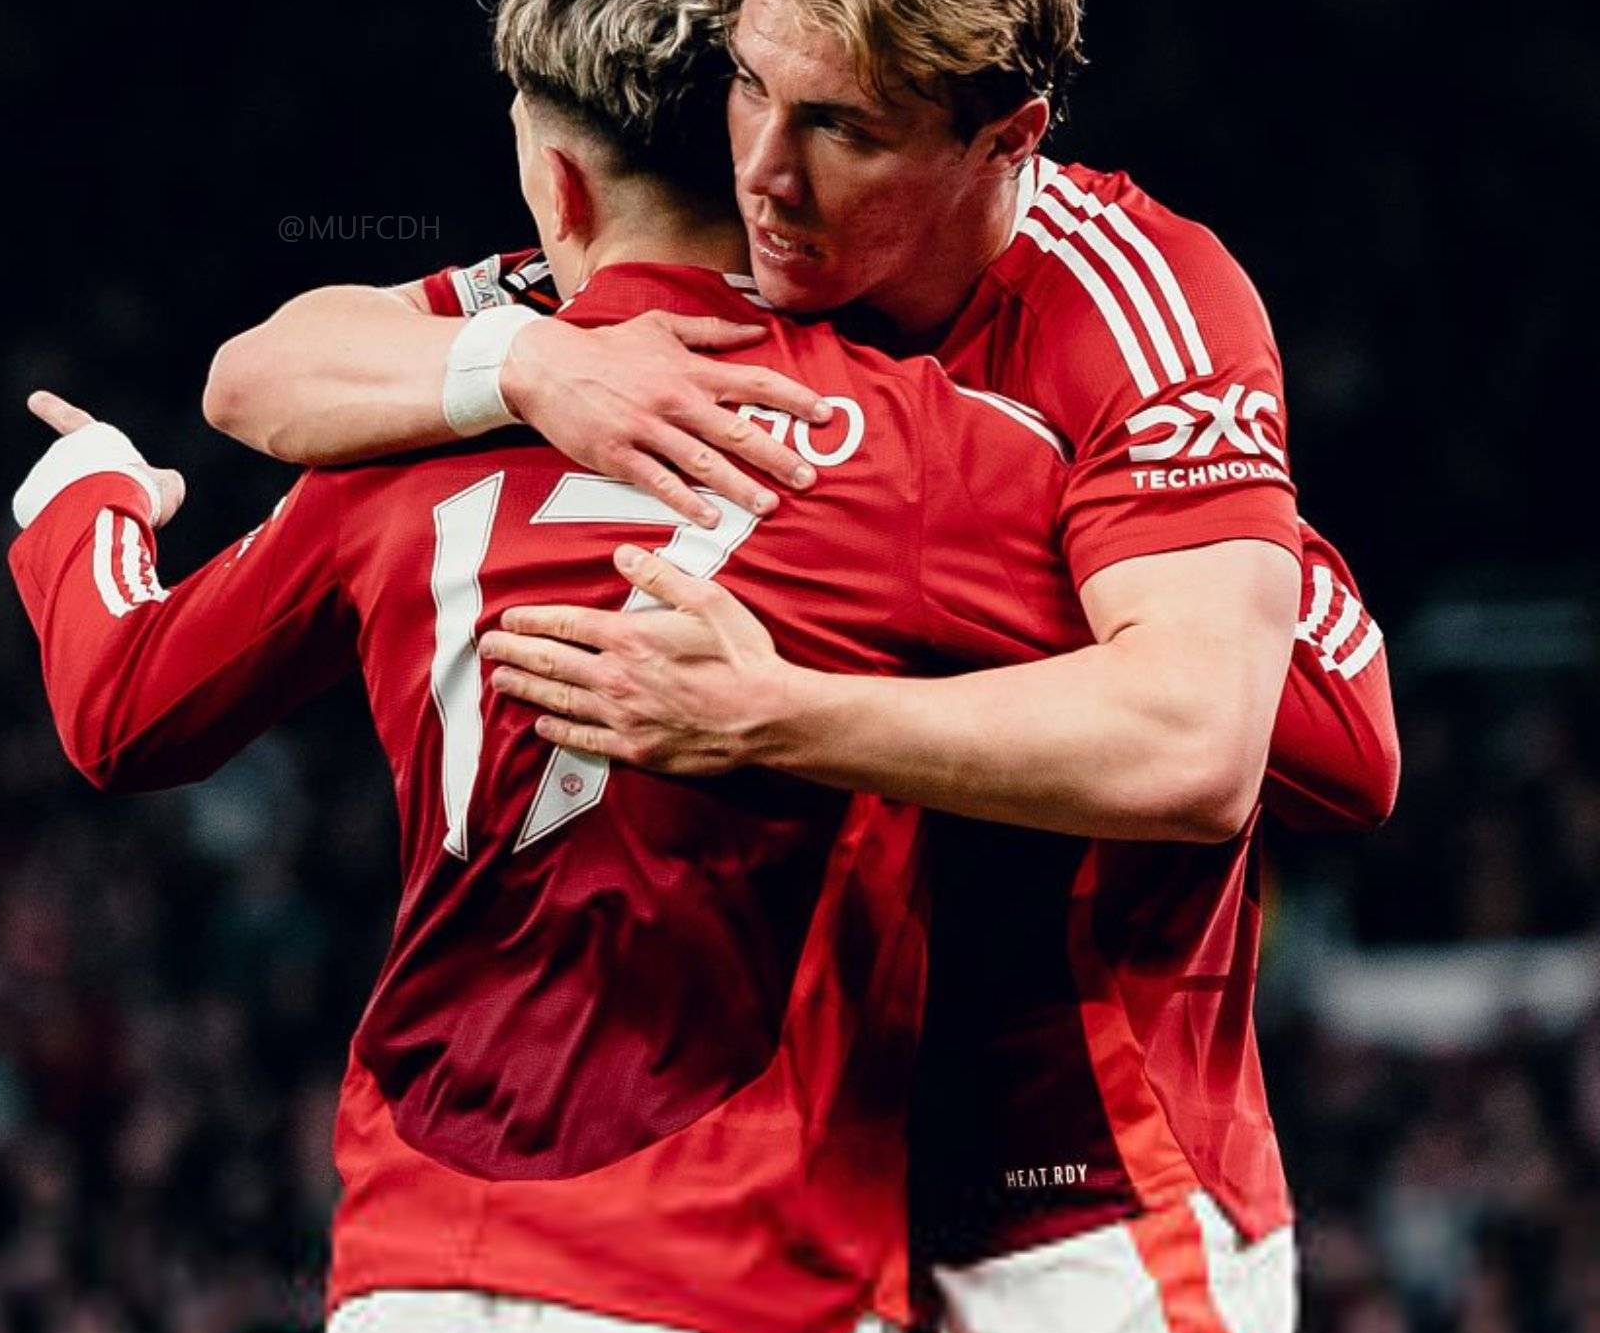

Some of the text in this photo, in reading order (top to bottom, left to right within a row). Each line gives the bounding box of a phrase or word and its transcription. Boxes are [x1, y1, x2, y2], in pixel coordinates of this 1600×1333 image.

[1131, 461, 1290, 490] TECHNOLO
[431, 470, 762, 861] 17
[1006, 1164, 1087, 1187] HEAT.RDY
